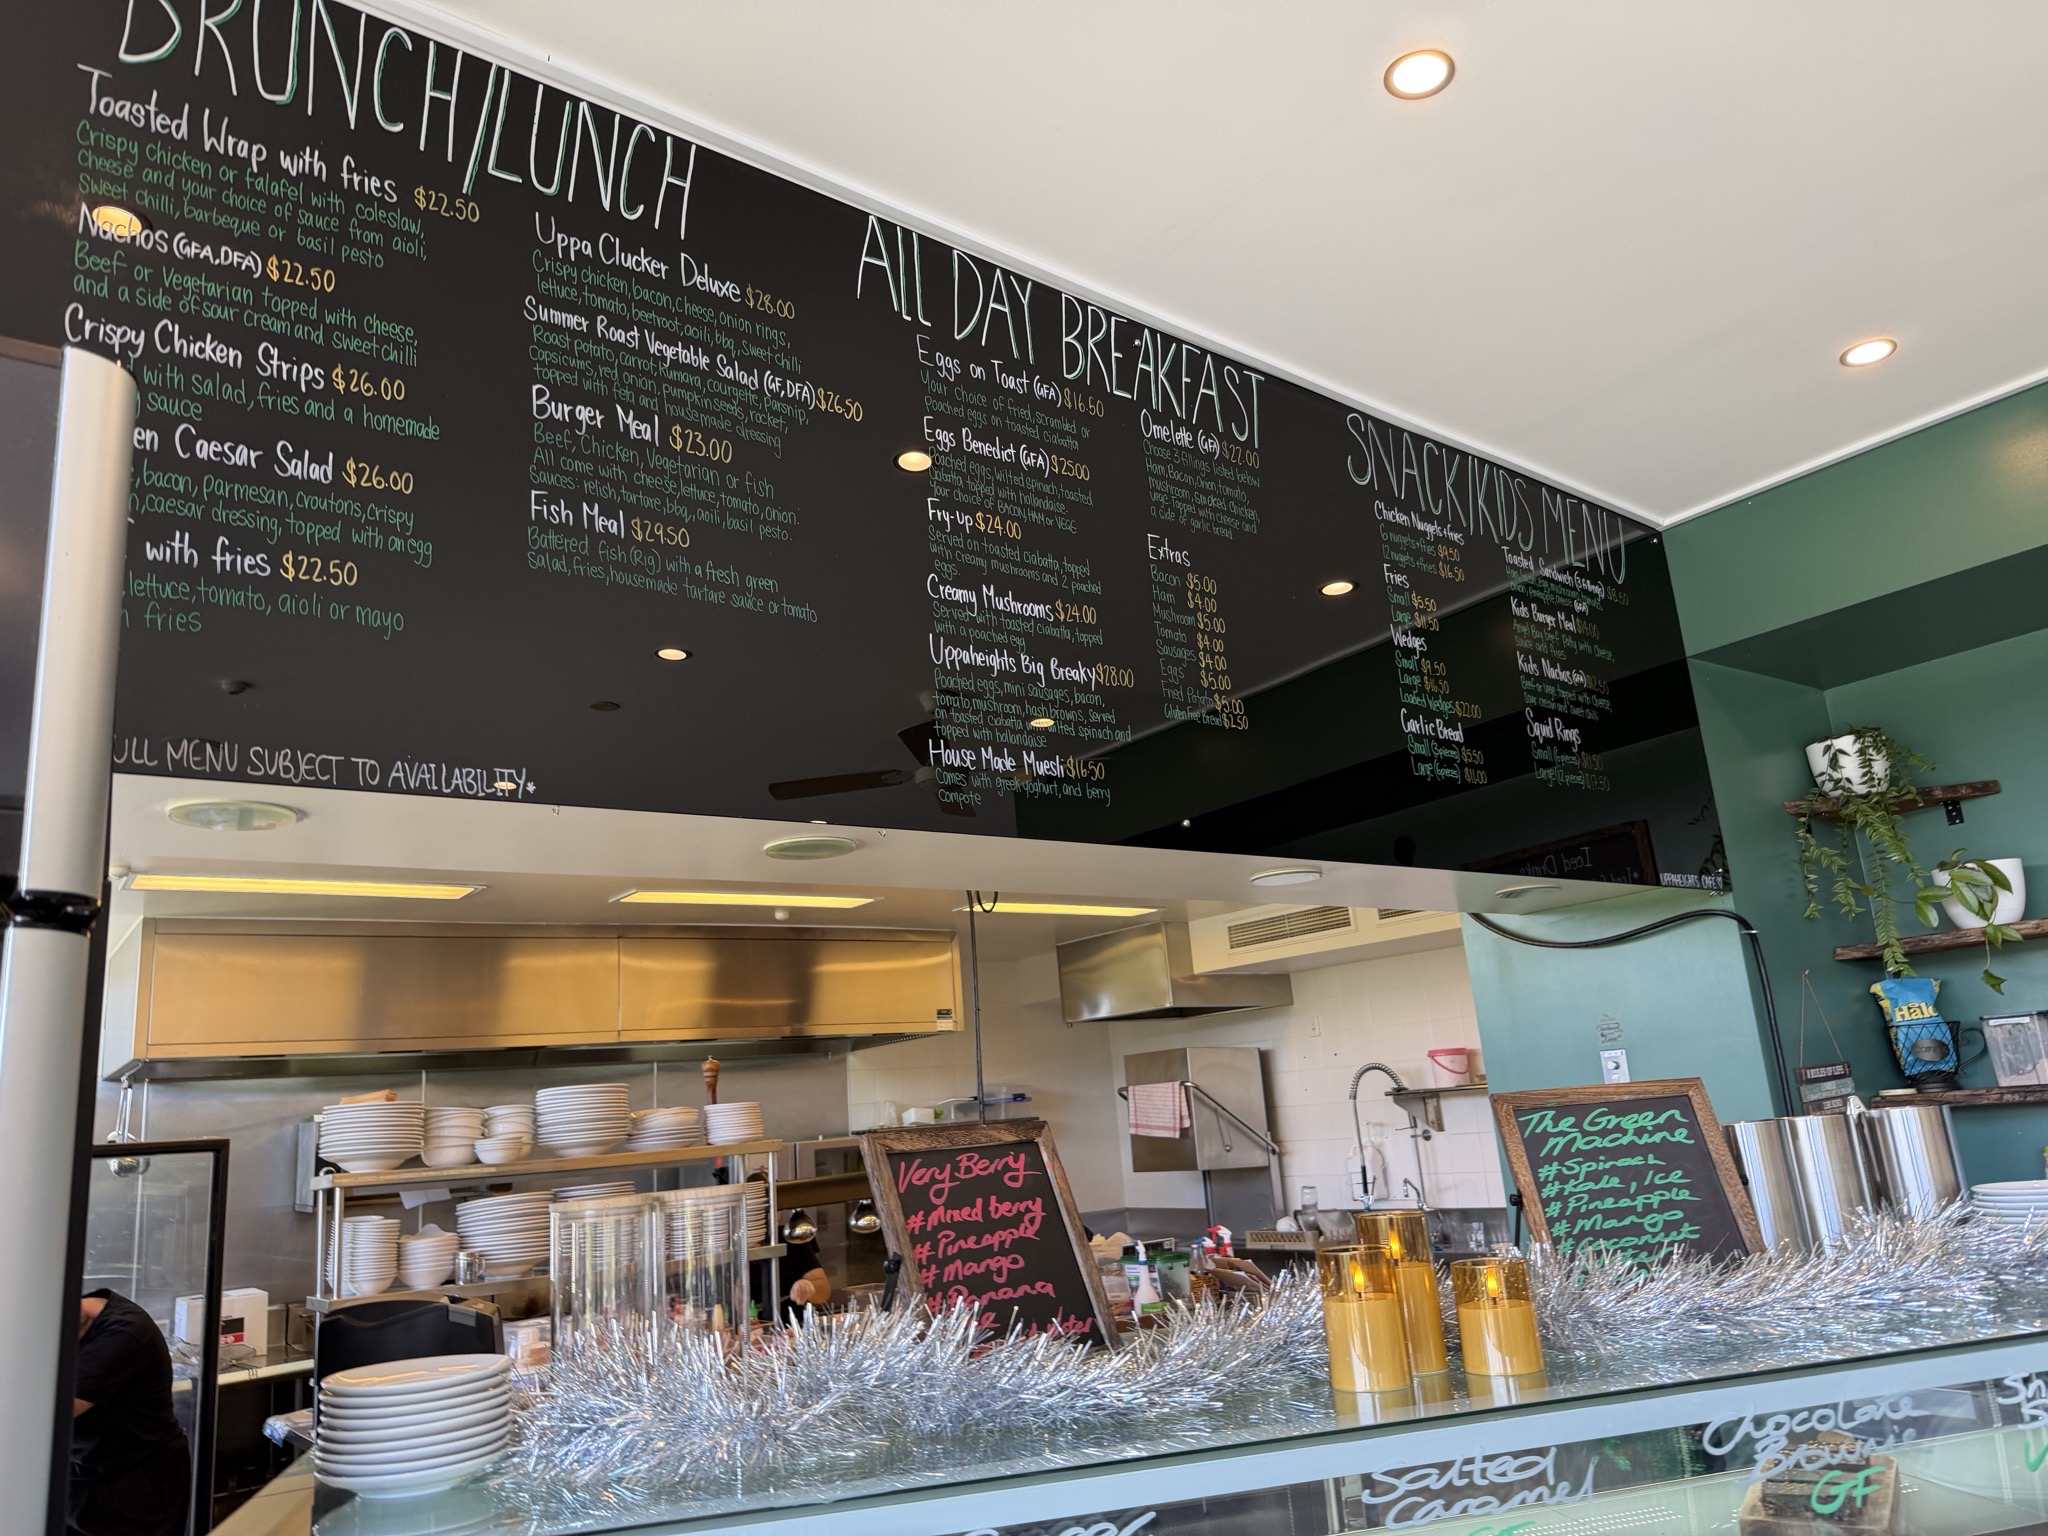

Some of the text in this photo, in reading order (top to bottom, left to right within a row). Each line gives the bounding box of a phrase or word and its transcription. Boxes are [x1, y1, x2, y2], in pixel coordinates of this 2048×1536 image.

[77, 63, 480, 222] Toasted Wrap with fries $22.50
[76, 119, 139, 166] Crispy
[219, 165, 239, 184] or
[245, 168, 303, 205] falafel
[311, 190, 346, 215] with
[355, 201, 425, 239] coleslaw,
[142, 167, 175, 191] and
[181, 176, 217, 201] your
[221, 189, 267, 214] choice
[274, 202, 293, 224] of
[297, 209, 339, 232] sauce
[348, 217, 384, 247] from
[78, 201, 169, 253] Nachos
[266, 254, 336, 292] $22.50
[535, 211, 795, 320] Uppa Clucker Deluxe $28.00
[64, 302, 406, 401] Crispy Chicken Strips $26.00
[523, 295, 590, 333] Summer
[596, 314, 640, 350] Roast
[644, 328, 711, 372] Vegetable
[715, 353, 759, 390] Salad
[816, 387, 863, 422] $26.50
[952, 248, 1035, 366] DAY
[1061, 292, 1265, 449] BREAKFAST
[916, 334, 961, 382] Eggs
[970, 363, 986, 381] on
[990, 359, 1030, 394] Toast
[1063, 387, 1105, 418] $16.50
[532, 384, 733, 464] Burger Meal $23.00
[923, 415, 956, 451] Eggs
[962, 427, 1017, 463] Benedict
[1140, 408, 1194, 449] Omelette
[1221, 440, 1259, 469] $22.00
[174, 423, 263, 470] Caesar
[273, 440, 334, 484] Salad
[341, 456, 414, 495] $26.00
[530, 489, 690, 548] Fish Meal $29.50
[975, 511, 1022, 540] $24.00
[1374, 500, 1411, 528] Chicken
[1541, 486, 1626, 585] MENU
[145, 529, 358, 587] with fries $22.50
[528, 525, 589, 556] Battered
[598, 540, 627, 564] fish
[665, 555, 691, 574] with
[694, 565, 702, 579] a
[705, 560, 740, 588] fresh
[746, 574, 779, 597] green
[1147, 533, 1191, 567] Extras
[1501, 546, 1574, 587] Toasted Sandwich
[926, 573, 1097, 625] Creamy Mushrooms $24.00
[1150, 563, 1217, 595] Bacon $5.00
[1152, 584, 1217, 613] Ham $4.00
[1383, 563, 1409, 589] Fries
[1387, 585, 1411, 606] Small
[1152, 602, 1196, 627] Mushroom
[1153, 621, 1188, 643] Tomato
[1510, 596, 1577, 634] Kids Burger Meal
[929, 633, 1135, 691] Uppaheights Big Breaky $28.00
[1155, 639, 1197, 668] Sausages
[1390, 623, 1428, 659] Wedges
[1394, 649, 1419, 672] Small
[1159, 658, 1185, 684] Eggs
[1516, 650, 1573, 685] Kids Nachos
[1161, 680, 1184, 702] Fried
[1186, 686, 1214, 708] Potato
[1400, 707, 1465, 743] Garlic Bread
[1525, 706, 1582, 753] Squid Rings
[166, 738, 239, 773] MENU
[247, 745, 344, 785] SUBJECT
[350, 756, 380, 787] TO
[928, 738, 977, 770] House
[981, 745, 1016, 772] Made
[1023, 750, 1064, 778] Muesli
[1518, 1107, 1689, 1139] The Green
[1539, 1126, 1696, 1157] Machine
[898, 1150, 1042, 1205] Very Berry
[1643, 1169, 1693, 1186] Ice
[1702, 1394, 1929, 1456] Chocolate
[1361, 1446, 1557, 1504] Salted
[1384, 1456, 1599, 1529] Caramel
[1810, 1465, 1887, 1515] GF
